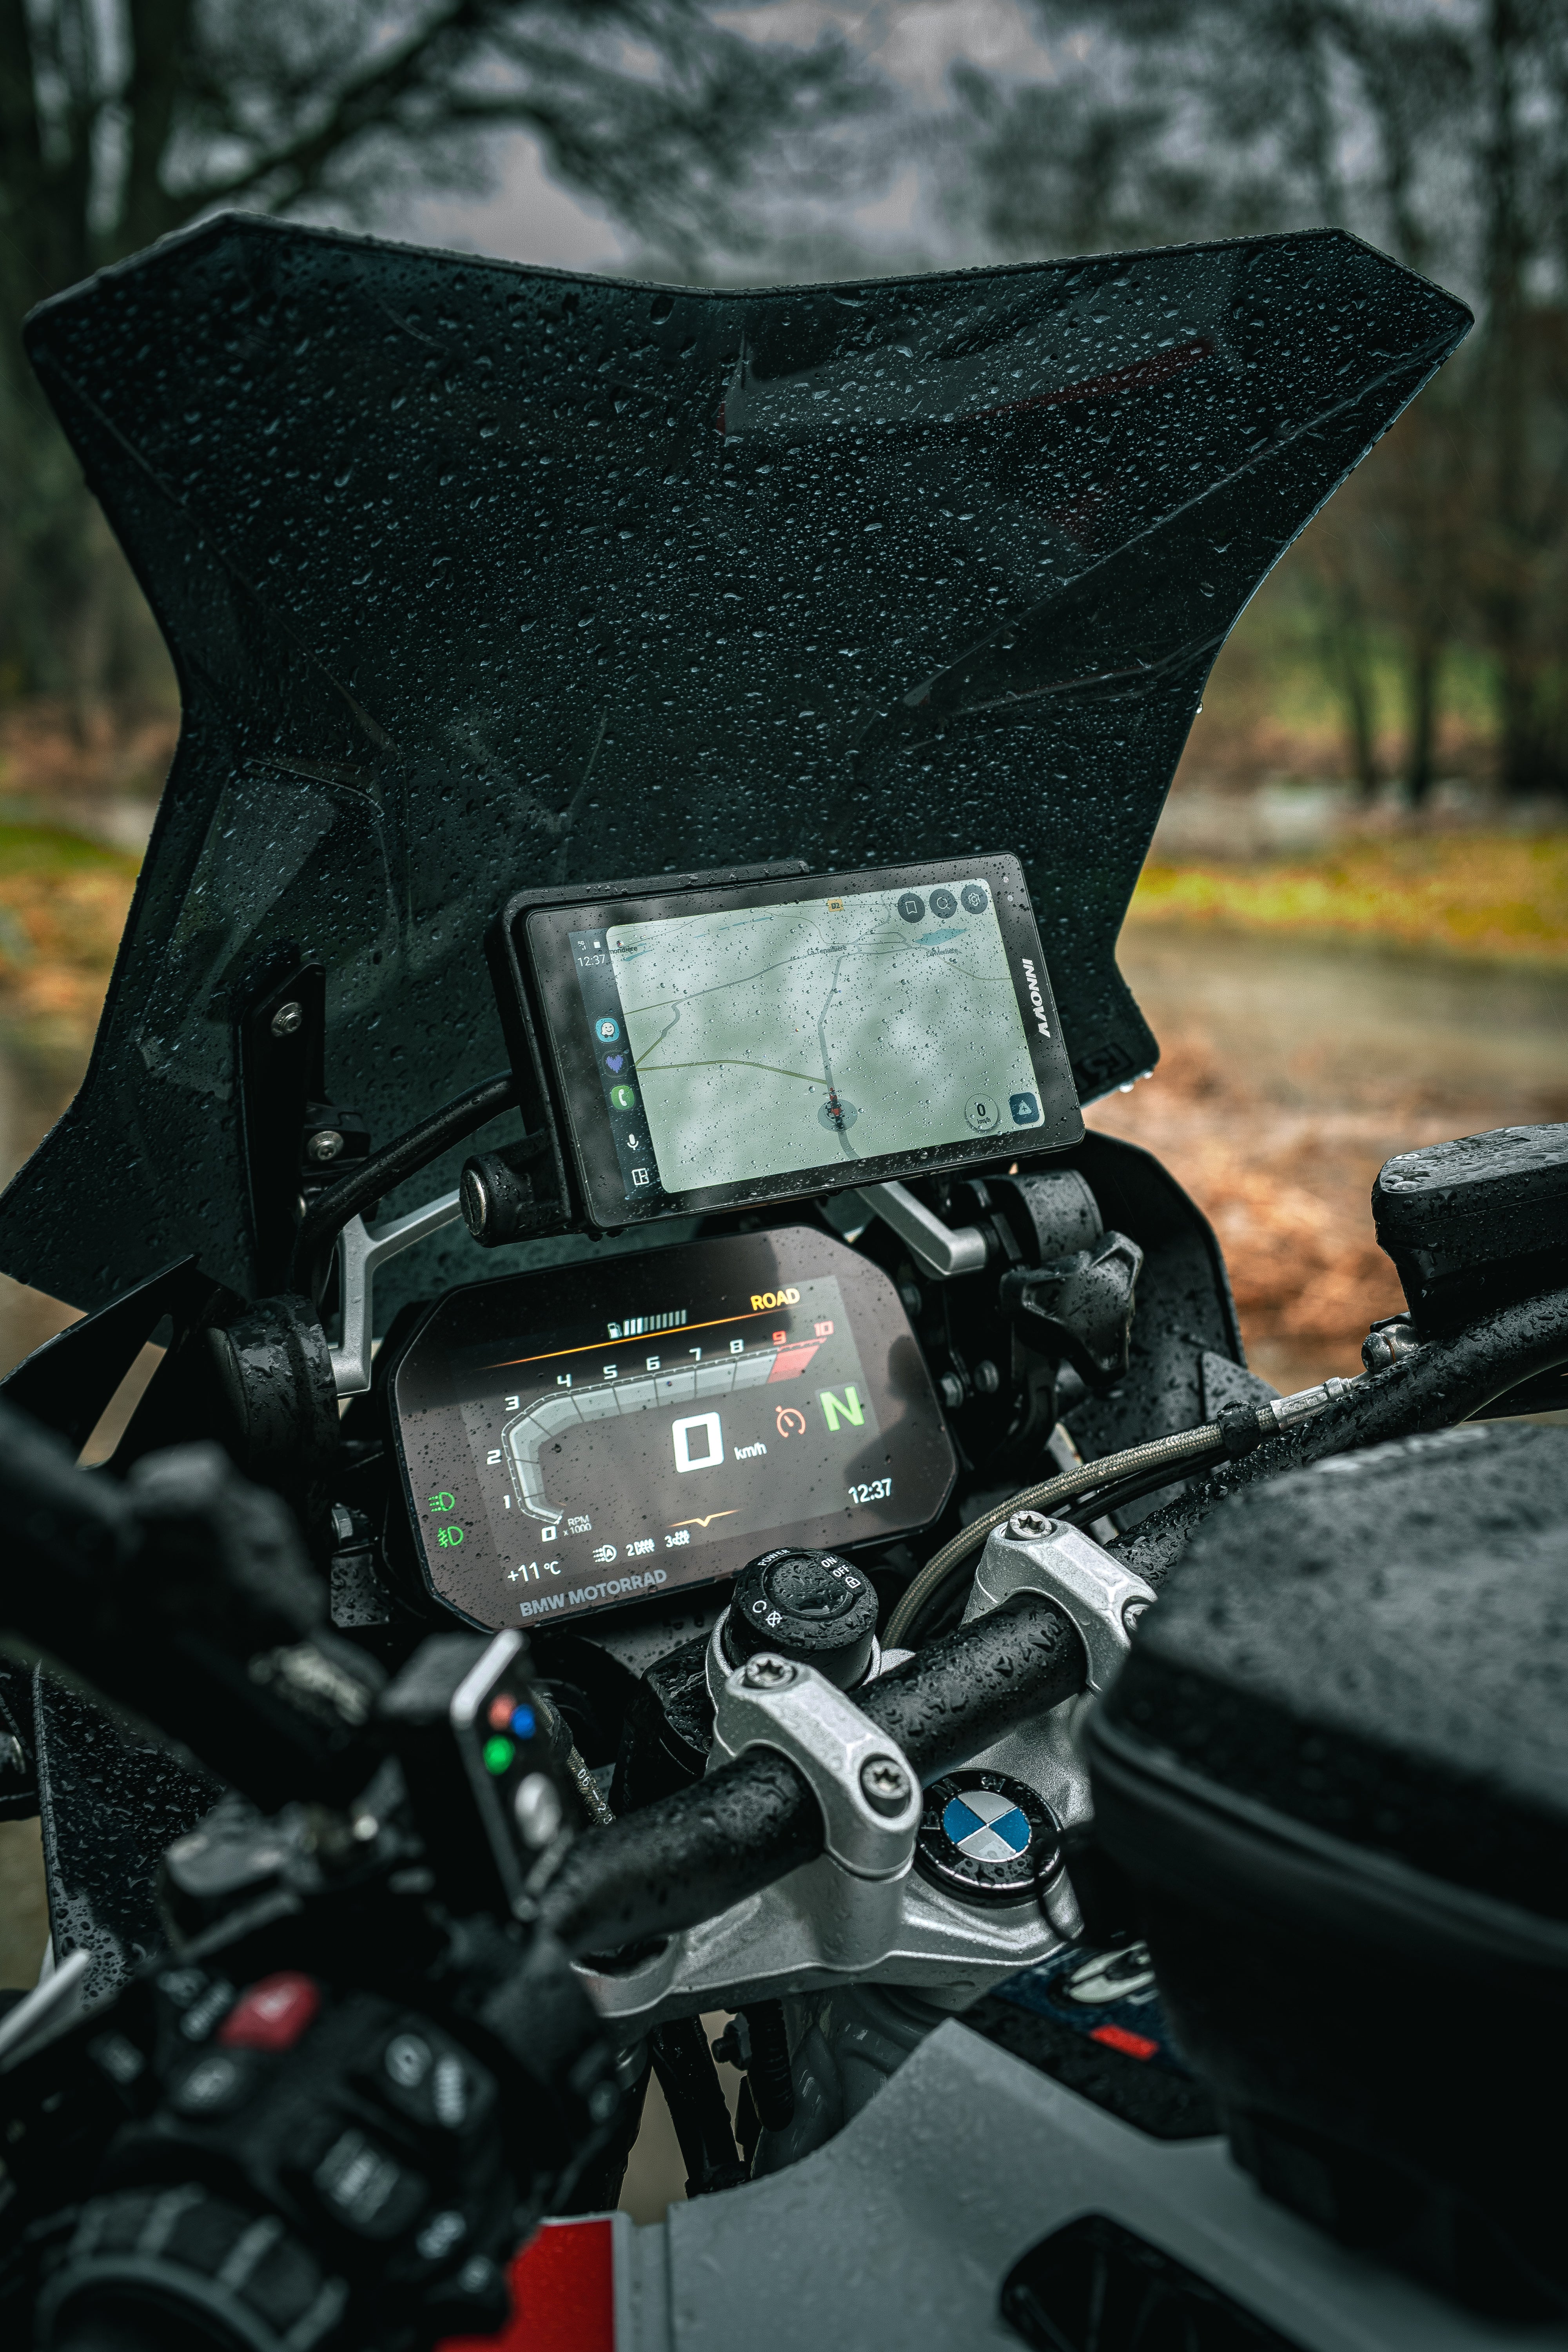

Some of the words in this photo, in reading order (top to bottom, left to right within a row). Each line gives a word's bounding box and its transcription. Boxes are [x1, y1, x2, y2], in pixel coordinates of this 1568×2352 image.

[577, 954, 606, 967] 12:37
[976, 1103, 986, 1117] 0
[750, 1288, 800, 1310] ROAD
[505, 1396, 519, 1411] 3
[557, 1374, 572, 1387] 4
[603, 1365, 618, 1379] 5
[646, 1356, 660, 1370] 6
[689, 1347, 701, 1361] 7
[730, 1339, 744, 1354] 8
[772, 1330, 787, 1345] 9
[813, 1320, 834, 1337] 10
[820, 1386, 865, 1431] N
[671, 1411, 724, 1474] 0
[734, 1442, 767, 1460] km/h
[486, 1449, 501, 1465] 2
[848, 1477, 892, 1504] 12:37
[503, 1495, 510, 1509] 1
[568, 1515, 589, 1526] RPM
[541, 1526, 557, 1542] 0
[569, 1523, 592, 1535] 1000
[757, 1549, 791, 1566] POWER
[821, 1556, 837, 1568] ON
[507, 1561, 540, 1582] +11
[544, 1561, 561, 1575] °C
[832, 1564, 851, 1577] OFF
[519, 1593, 564, 1617] BMW
[569, 1569, 667, 1606] MOTORRAD
[921, 1773, 1006, 1830] BMW
